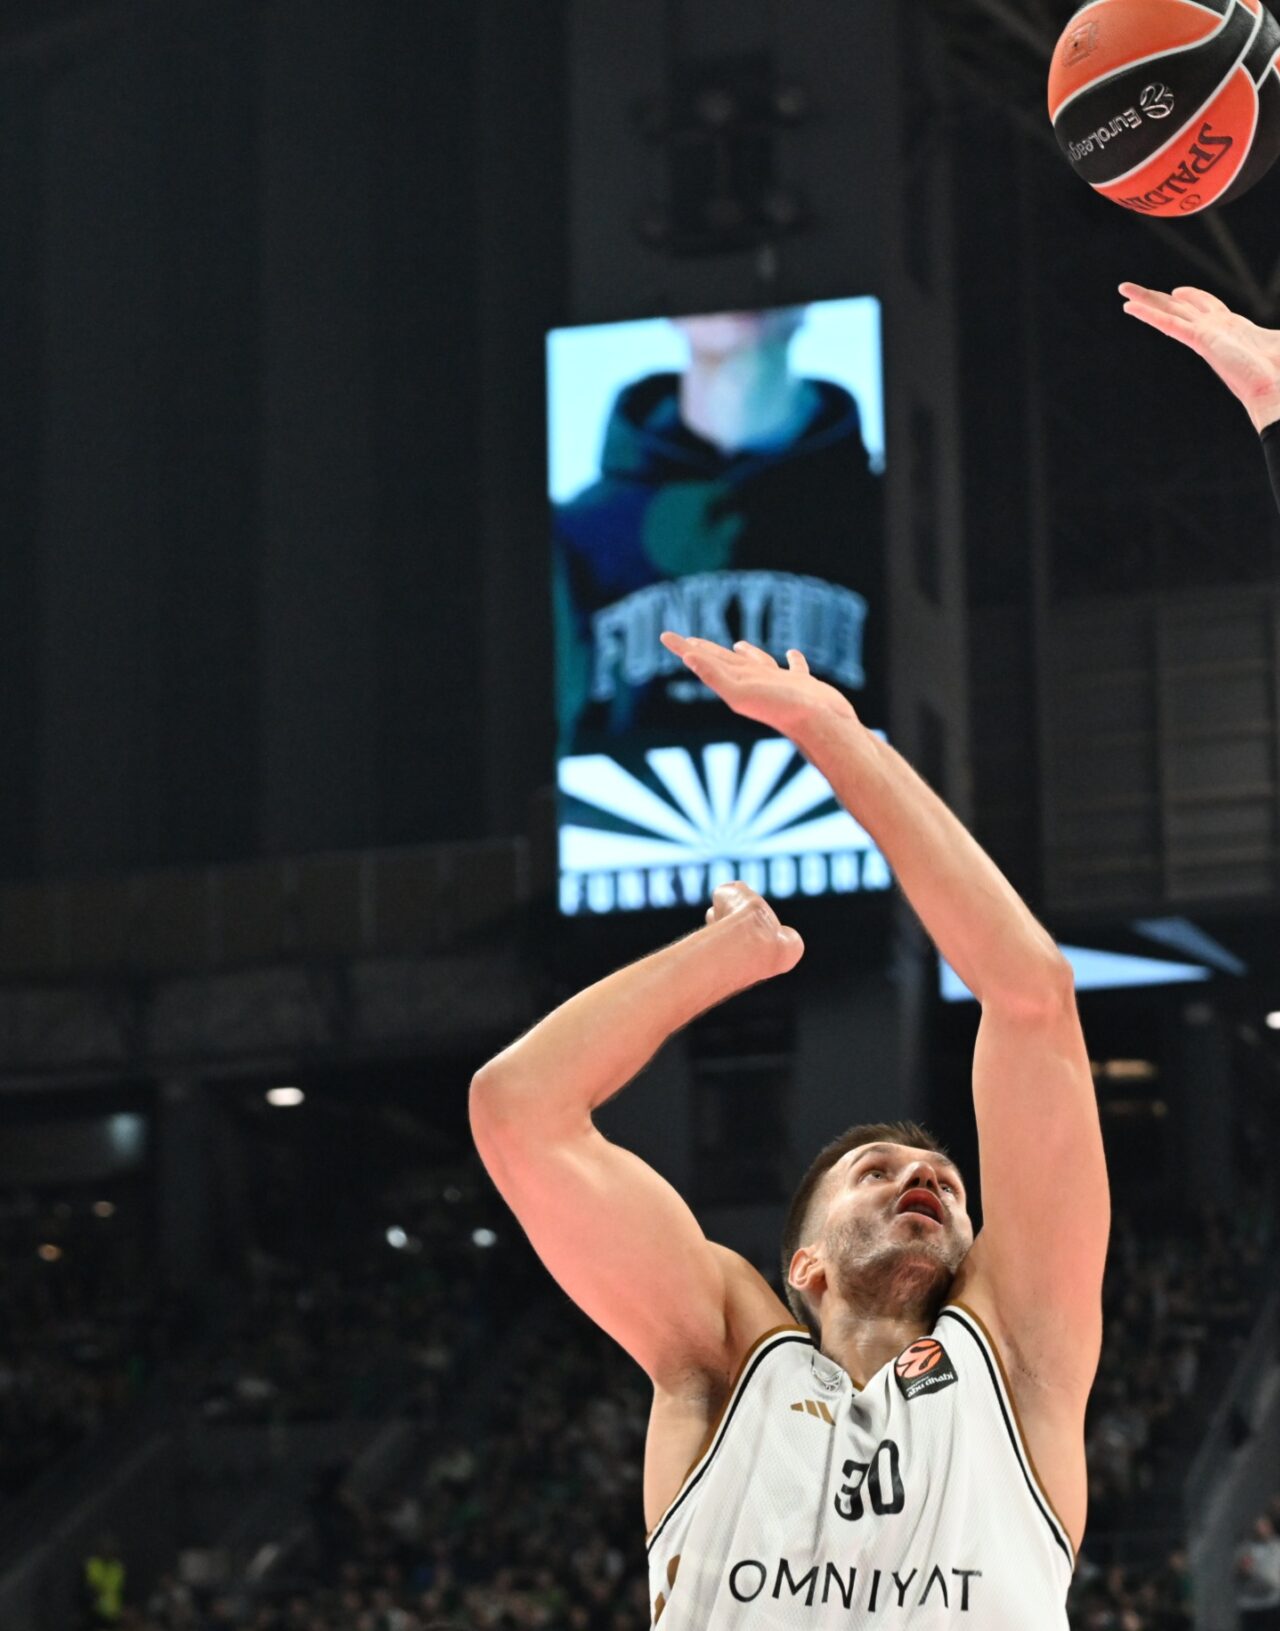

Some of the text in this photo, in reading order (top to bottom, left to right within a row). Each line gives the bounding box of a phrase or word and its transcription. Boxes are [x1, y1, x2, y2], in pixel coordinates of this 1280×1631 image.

[1067, 107, 1142, 161] EuroLeag
[1118, 122, 1233, 211] SPALDIN
[834, 1439, 905, 1522] 30
[728, 1557, 983, 1613] OMNIYAT
